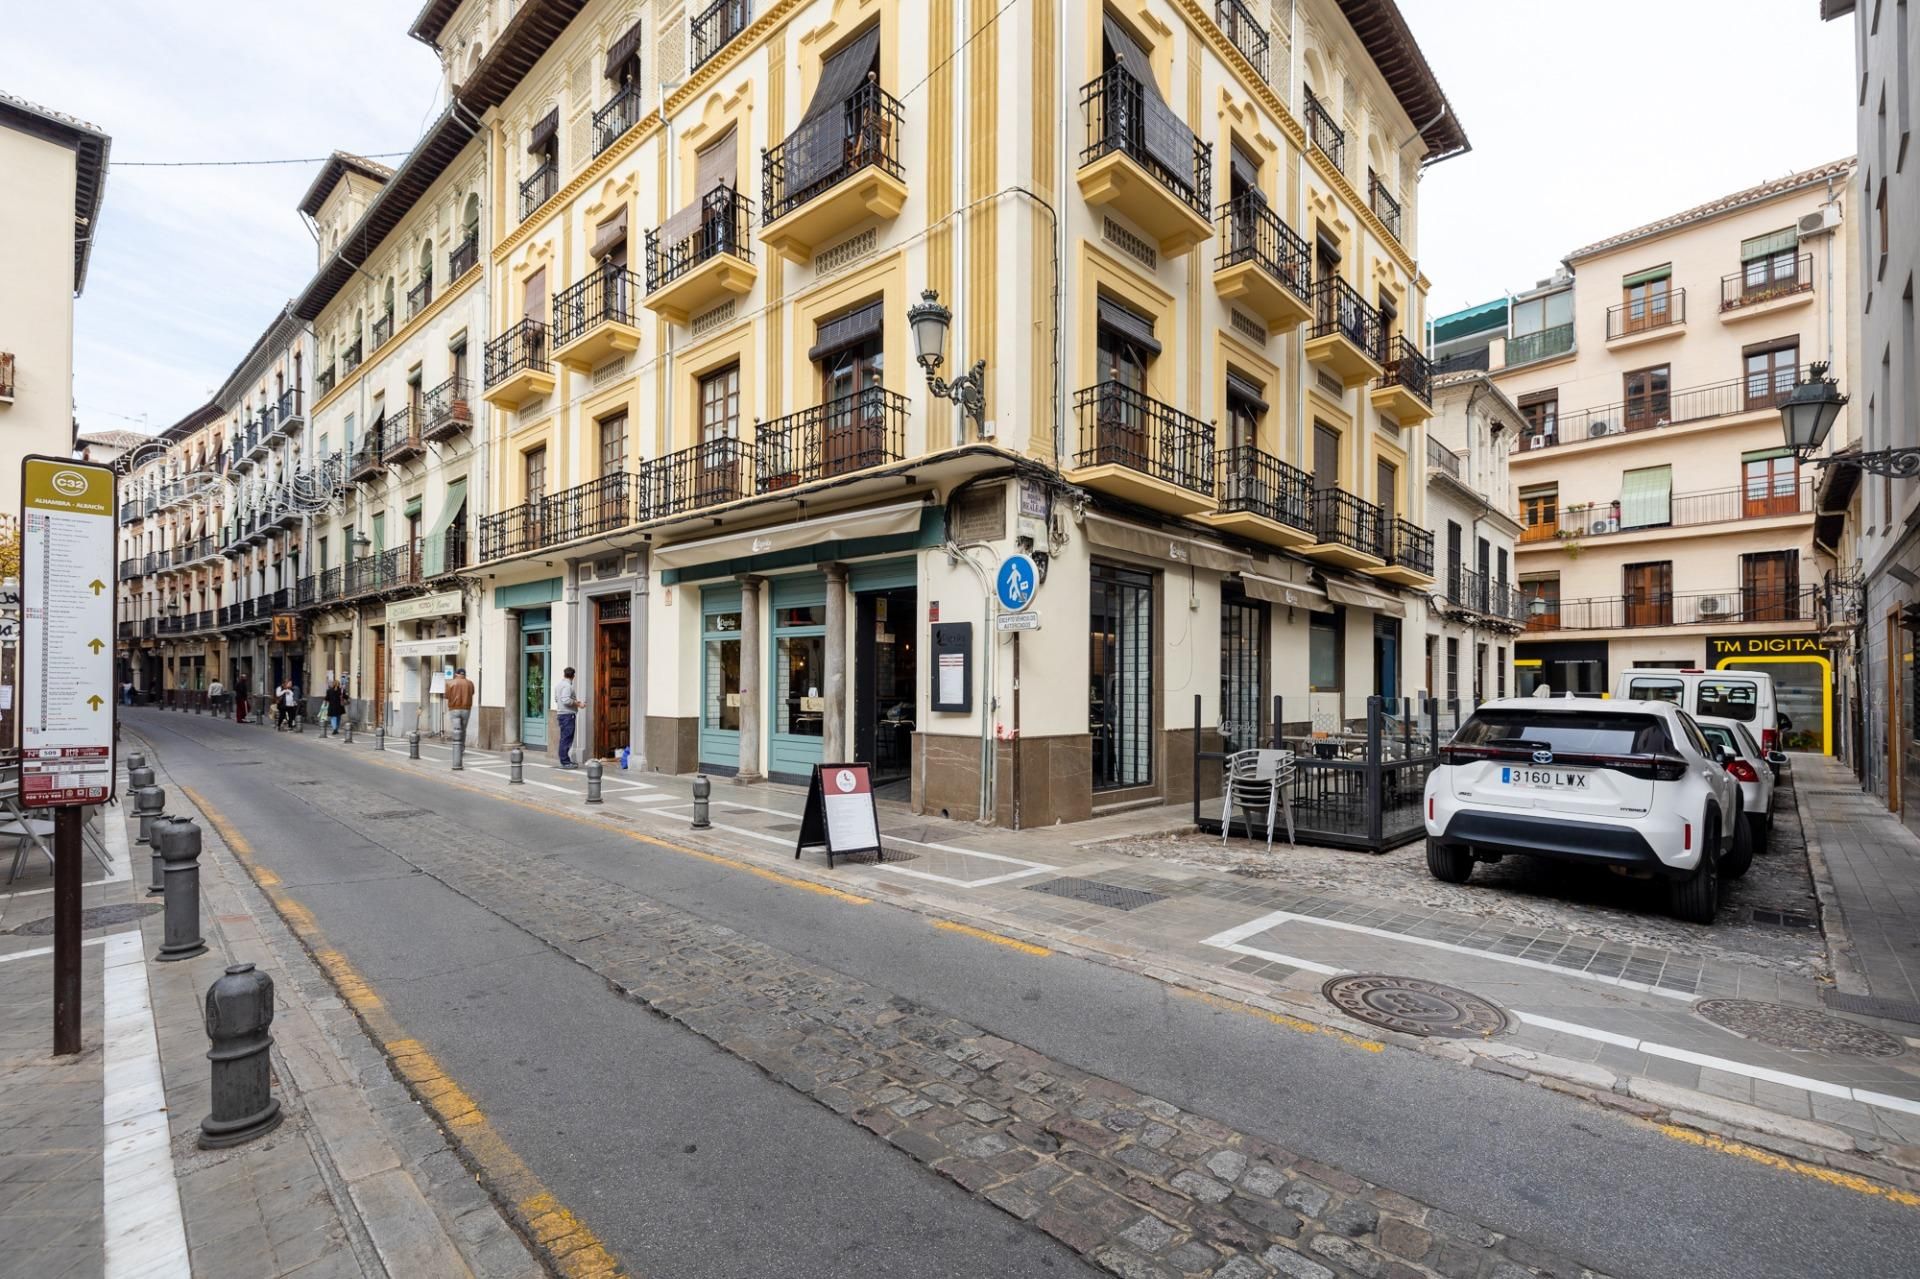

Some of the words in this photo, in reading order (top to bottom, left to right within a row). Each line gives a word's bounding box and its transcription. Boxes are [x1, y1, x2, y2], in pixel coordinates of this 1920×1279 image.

[57, 478, 84, 489] C32
[34, 498, 71, 507] ALHAMBRA
[1713, 640, 1741, 652] TM
[1748, 639, 1829, 652] DIGITAL
[1513, 770, 1551, 784] 3160
[1555, 773, 1585, 787] LWX
